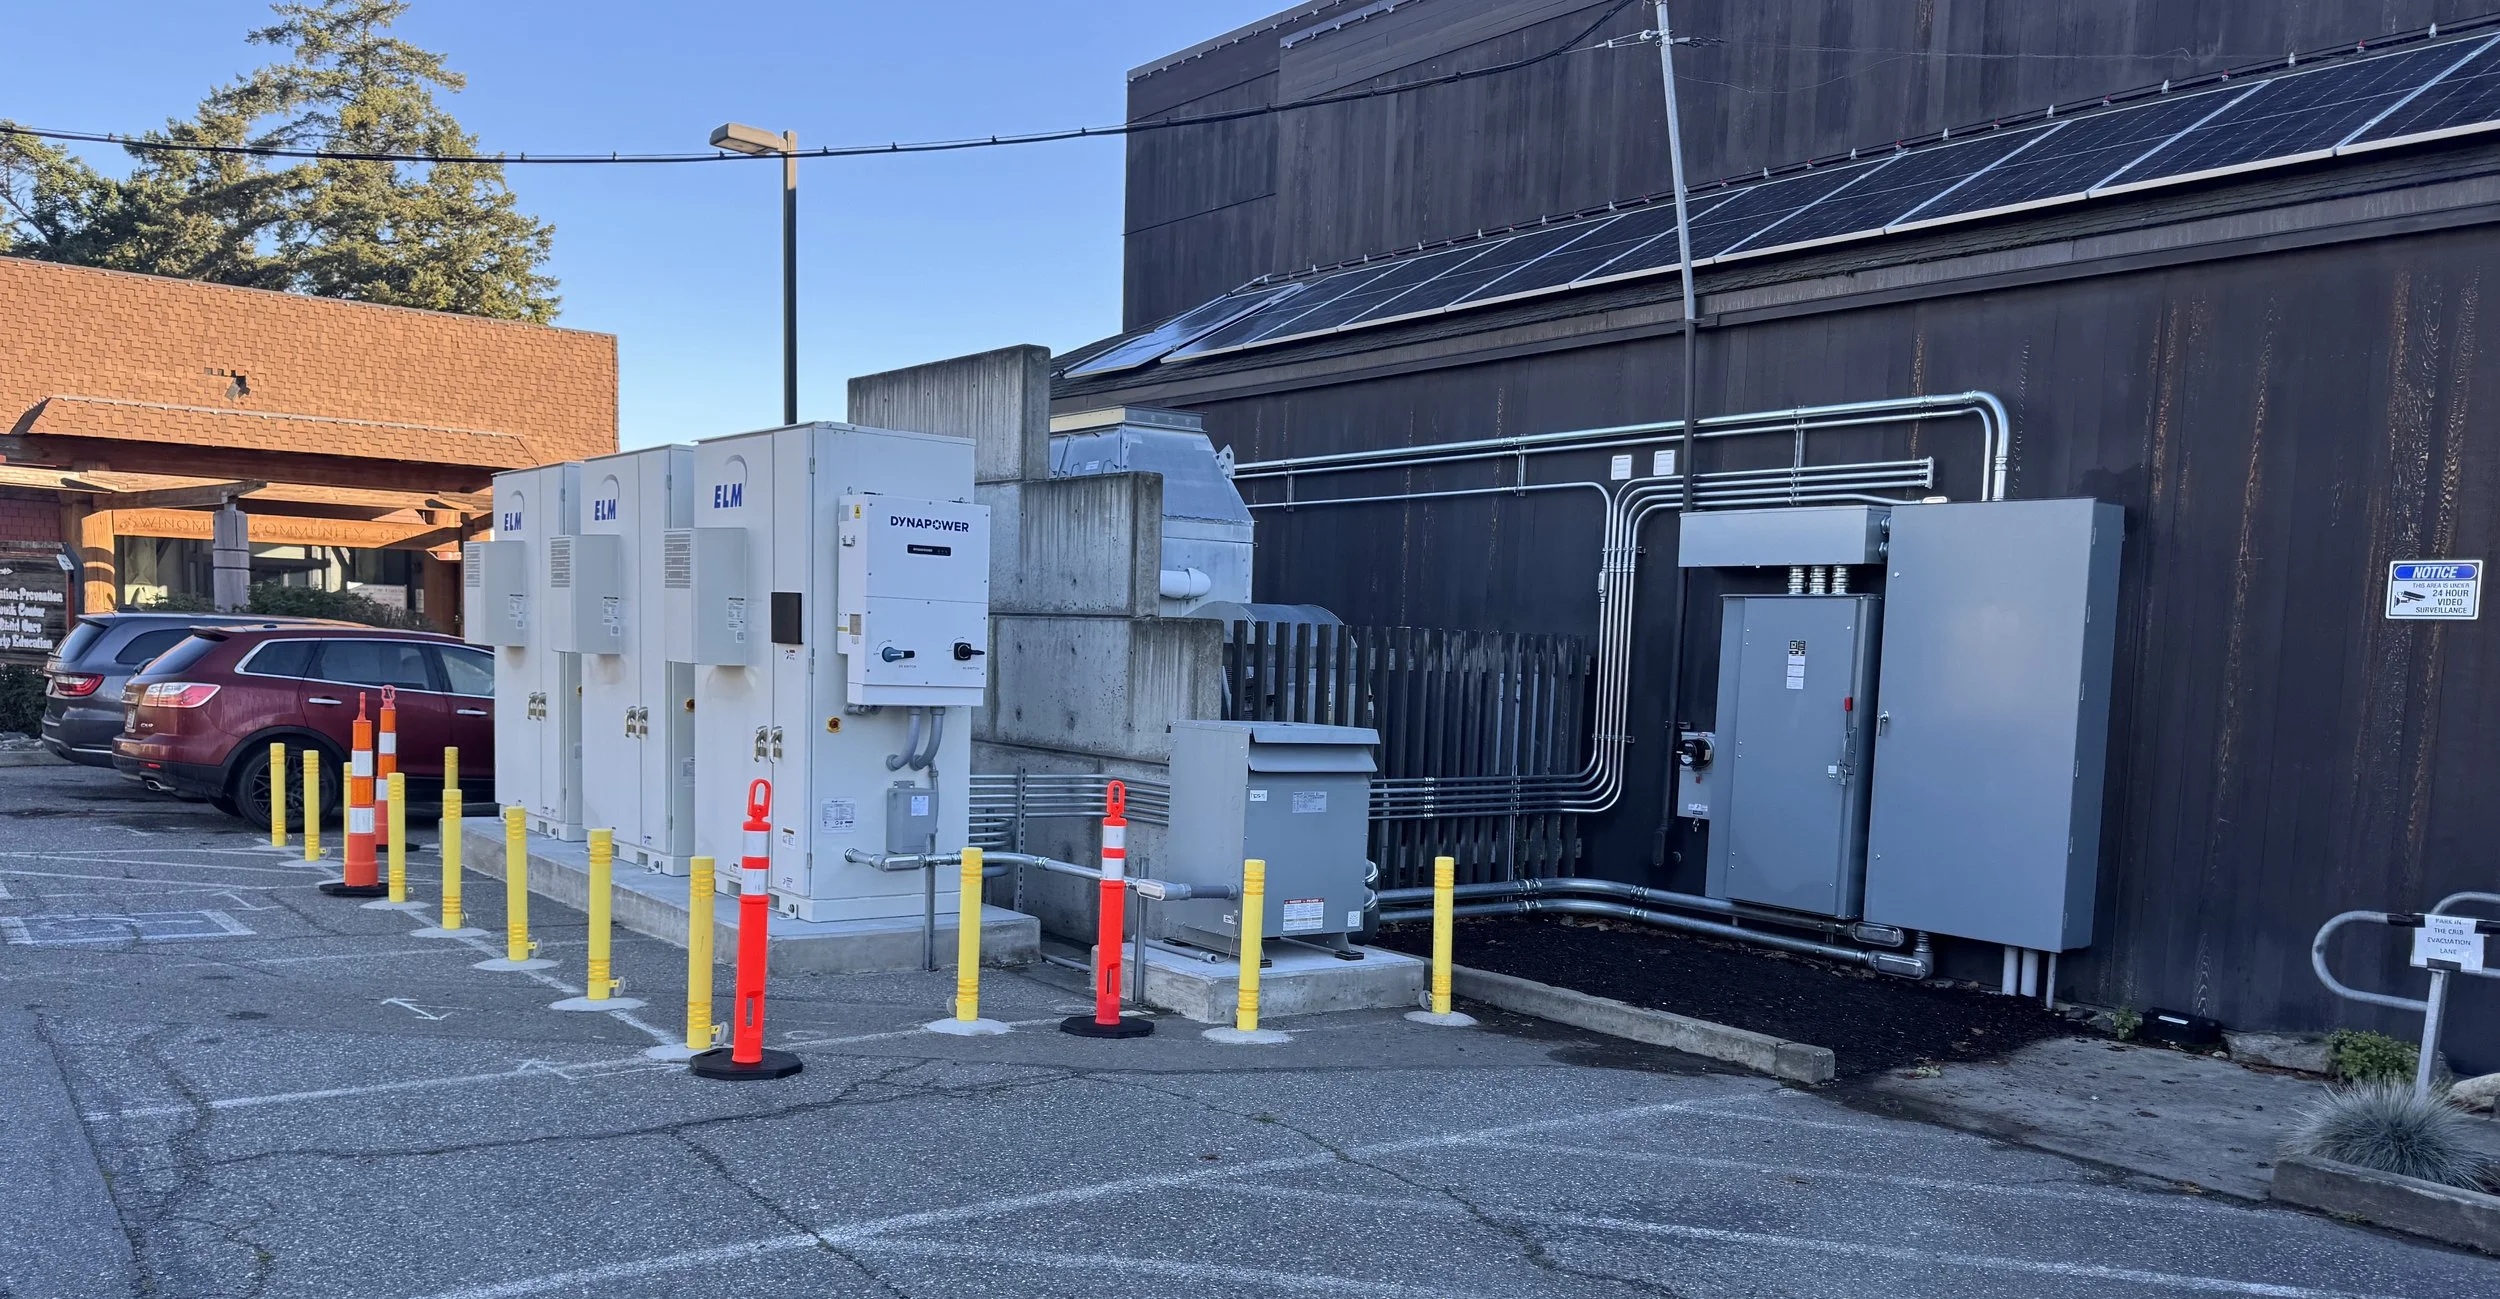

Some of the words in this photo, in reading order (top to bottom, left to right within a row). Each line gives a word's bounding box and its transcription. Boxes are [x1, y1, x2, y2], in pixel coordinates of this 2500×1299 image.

[714, 483, 743, 508] ELM
[595, 499, 617, 521] ELM
[504, 512, 522, 531] ELM
[890, 515, 969, 533] DYNAPOWER
[252, 522, 365, 540] COMMUNITY
[2413, 566, 2459, 579] NOTICE
[2432, 589, 2443, 597] 24
[2445, 589, 2469, 597] HOUR
[2437, 598, 2463, 606] VIDEO
[2415, 606, 2467, 614] SURVEILLANCE
[2434, 927, 2447, 935] THE
[2427, 936, 2471, 946] EVACUATION
